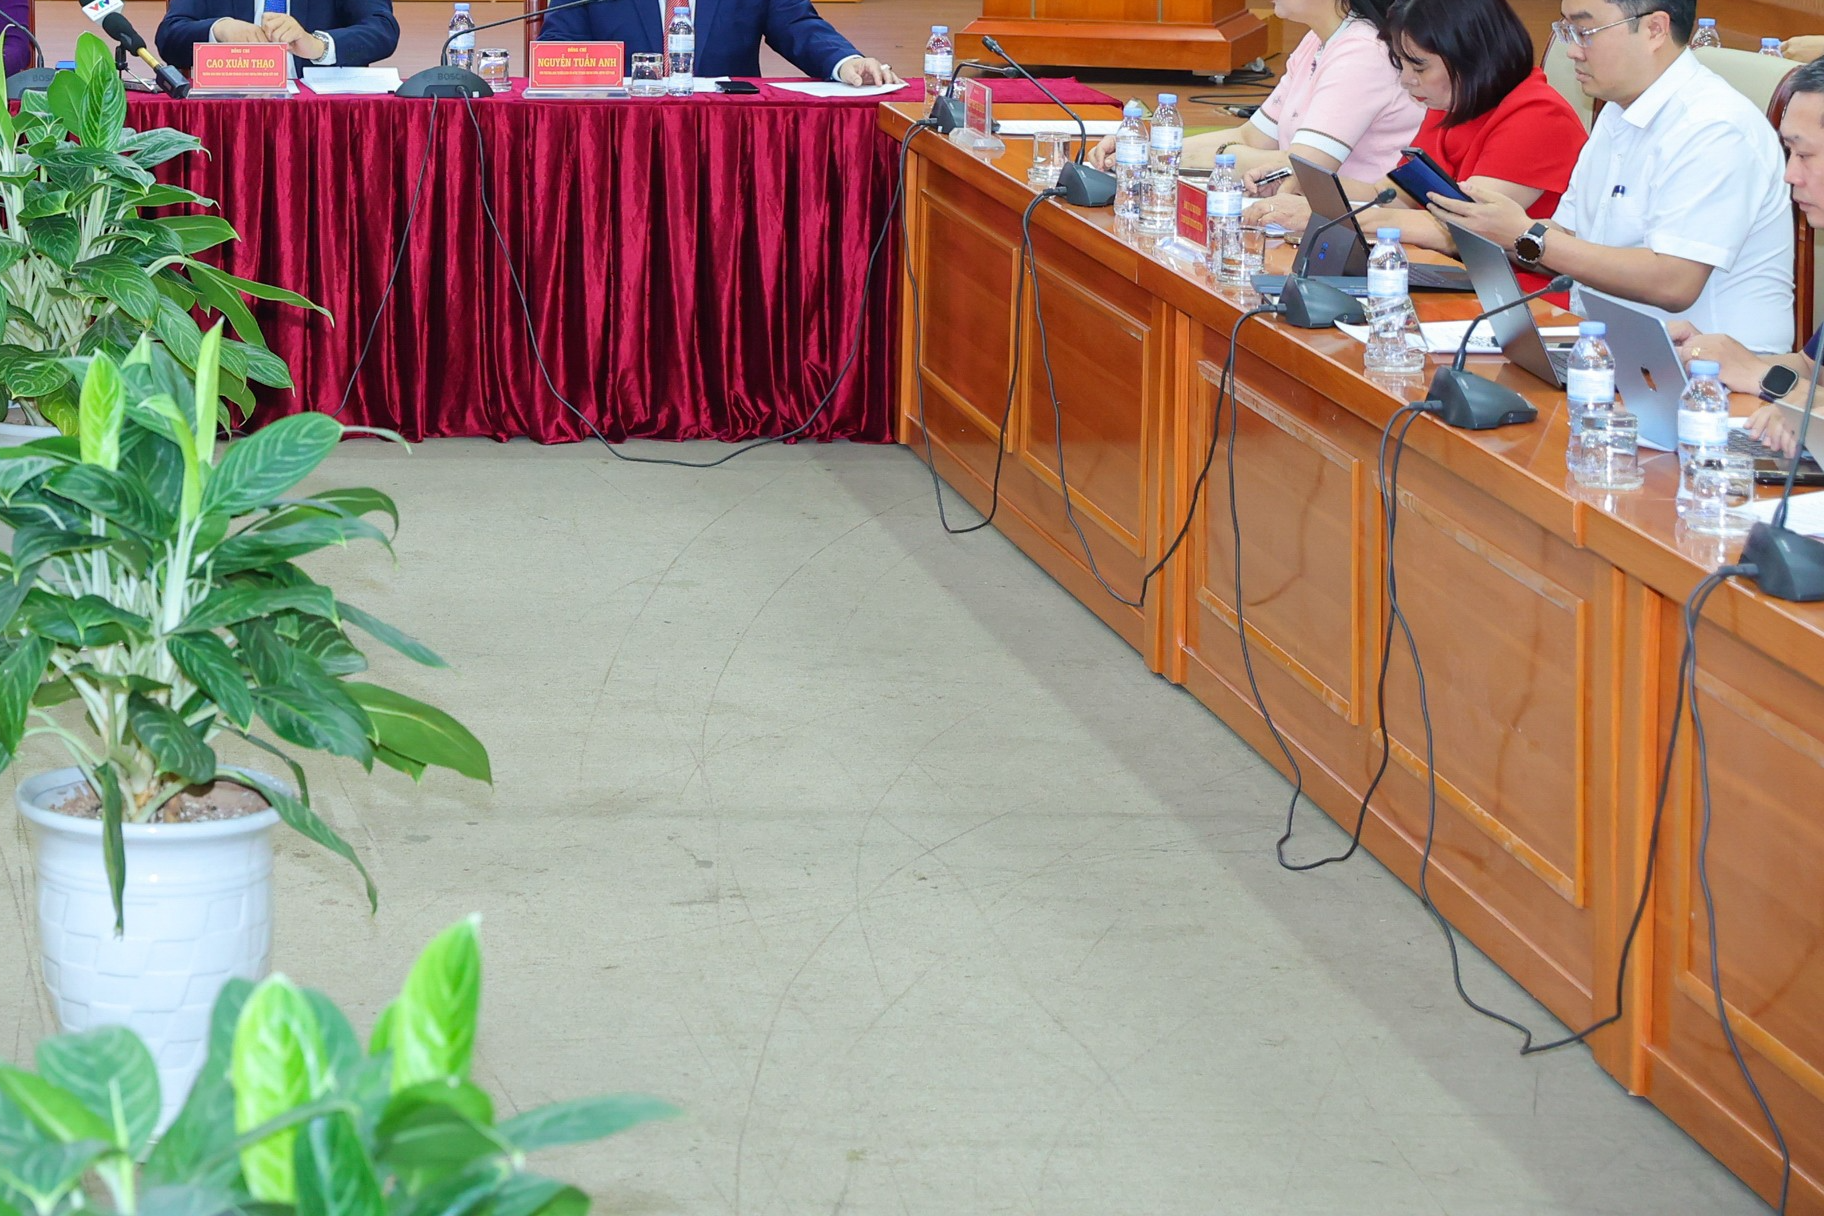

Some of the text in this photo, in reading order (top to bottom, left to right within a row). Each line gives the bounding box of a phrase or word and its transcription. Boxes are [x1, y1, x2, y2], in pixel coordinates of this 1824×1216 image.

[206, 56, 275, 70] CAO XUÂN THẠO
[537, 53, 617, 68] NGUYỄN TUẤN ANH
[32, 74, 52, 82] BOS
[437, 72, 468, 81] BOSCH
